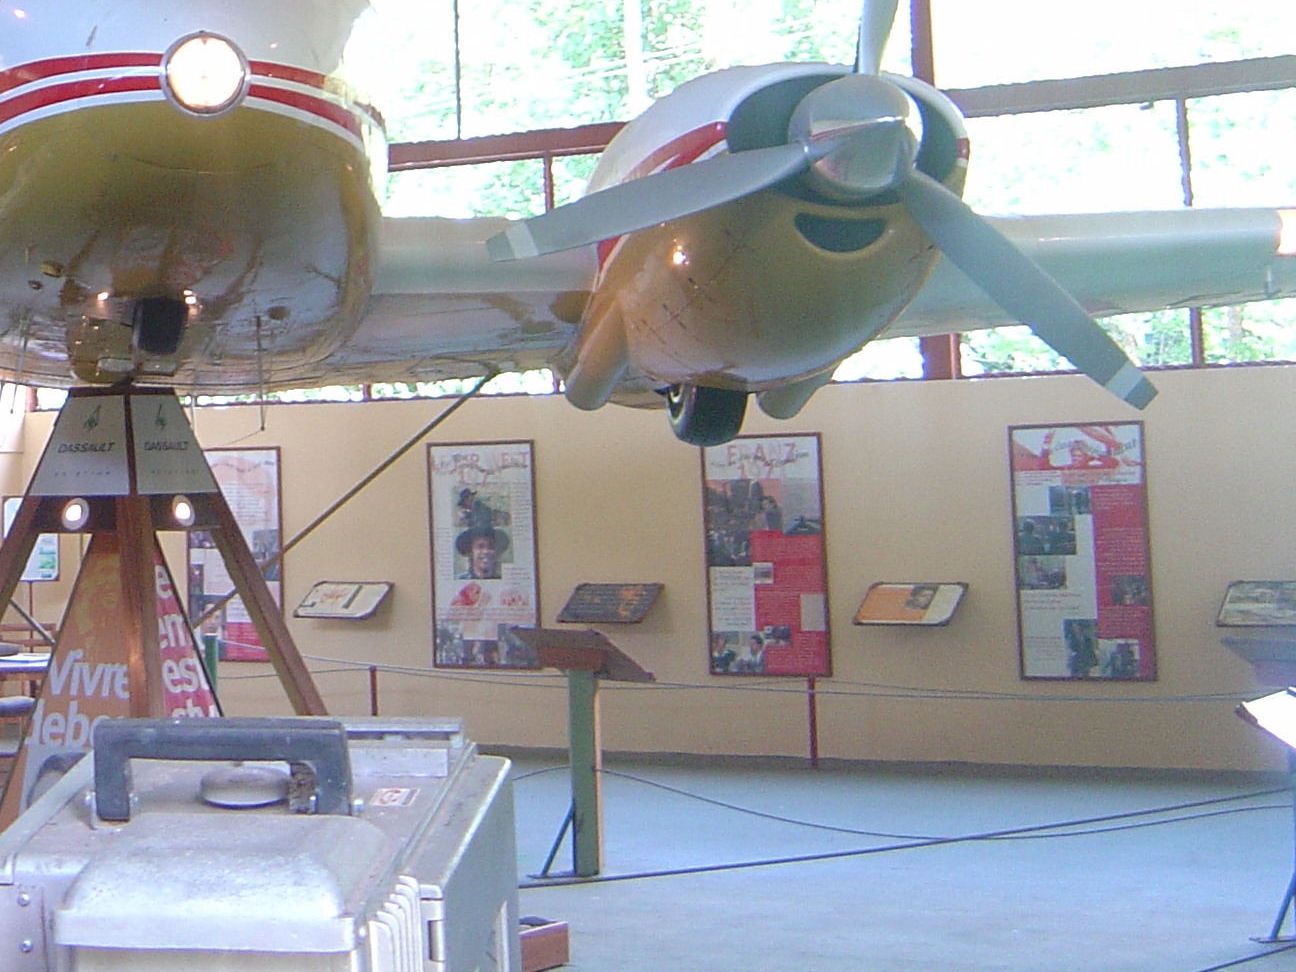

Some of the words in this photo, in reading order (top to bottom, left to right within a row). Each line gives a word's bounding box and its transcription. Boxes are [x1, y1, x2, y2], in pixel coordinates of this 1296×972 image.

[57, 441, 116, 454] DASSAULT
[143, 440, 189, 452] DASSAULT
[49, 648, 130, 699] Vivre
